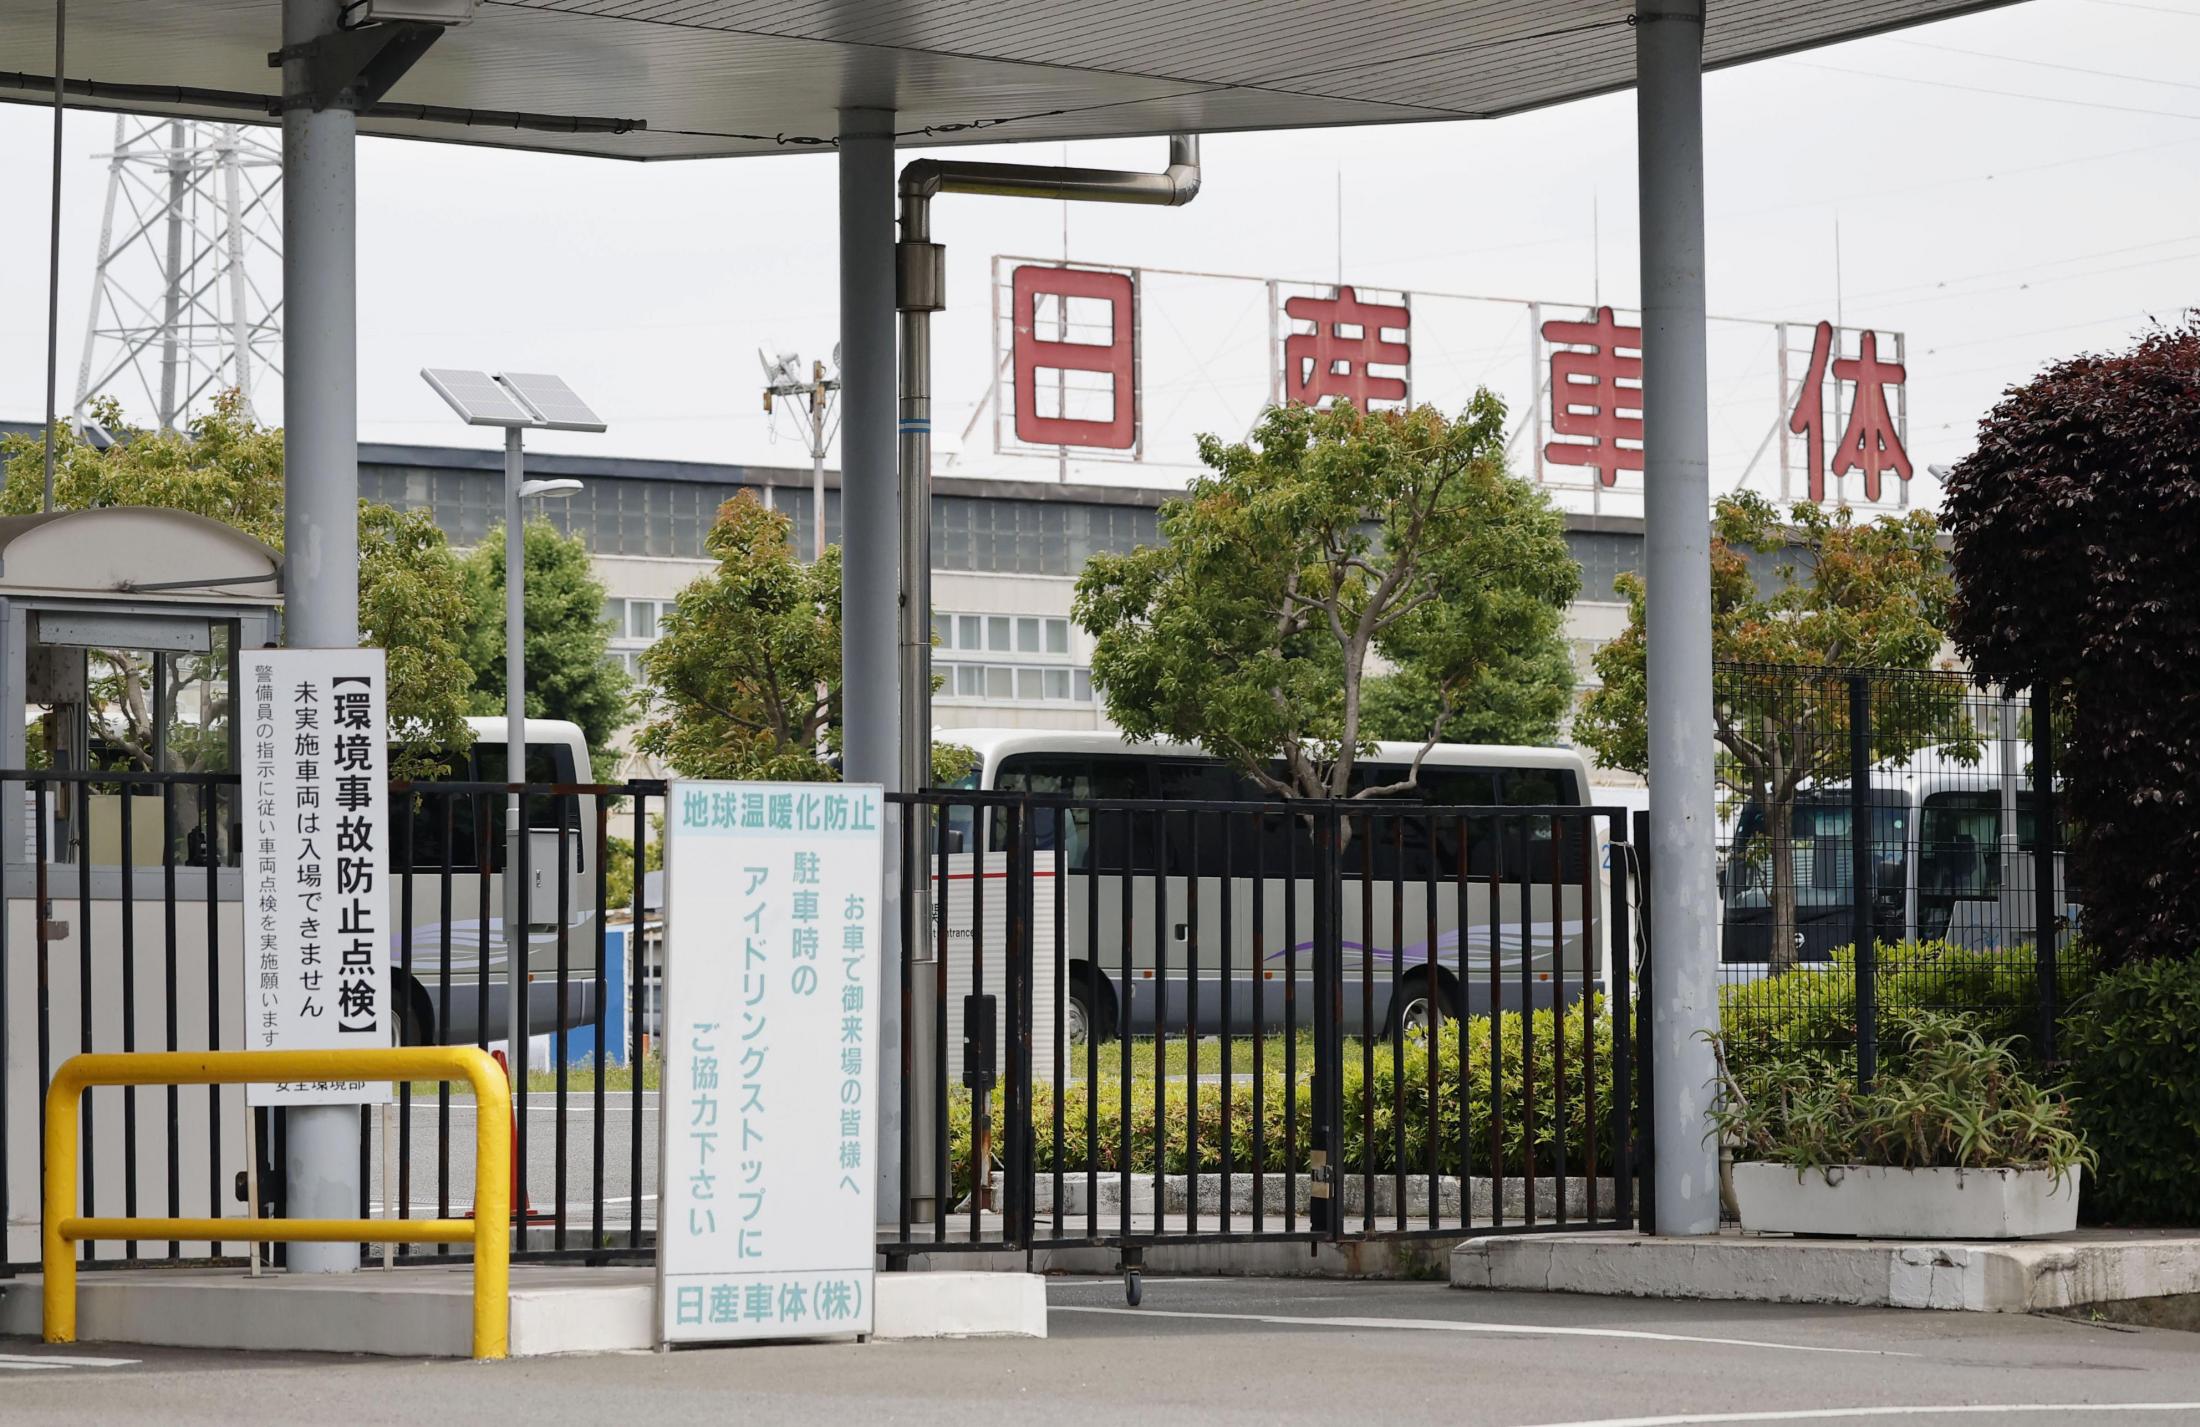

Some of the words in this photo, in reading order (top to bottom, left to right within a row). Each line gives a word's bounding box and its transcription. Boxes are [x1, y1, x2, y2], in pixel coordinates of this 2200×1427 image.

[255, 664, 279, 1048] 警備員の指示に従い車両点検を実施願います
[294, 680, 324, 1018] 未実施車両は入場できません
[332, 676, 377, 1033] 【環境事故防止点検】
[682, 791, 876, 832] 地球温暖化防止
[790, 851, 821, 997] 駐車時の
[689, 1022, 720, 1237] ご協力下さい
[737, 866, 769, 1259] アイドリングストップに
[839, 893, 866, 1196] お車で御来場の皆様へ
[676, 1281, 862, 1327] 日産車体(株)
